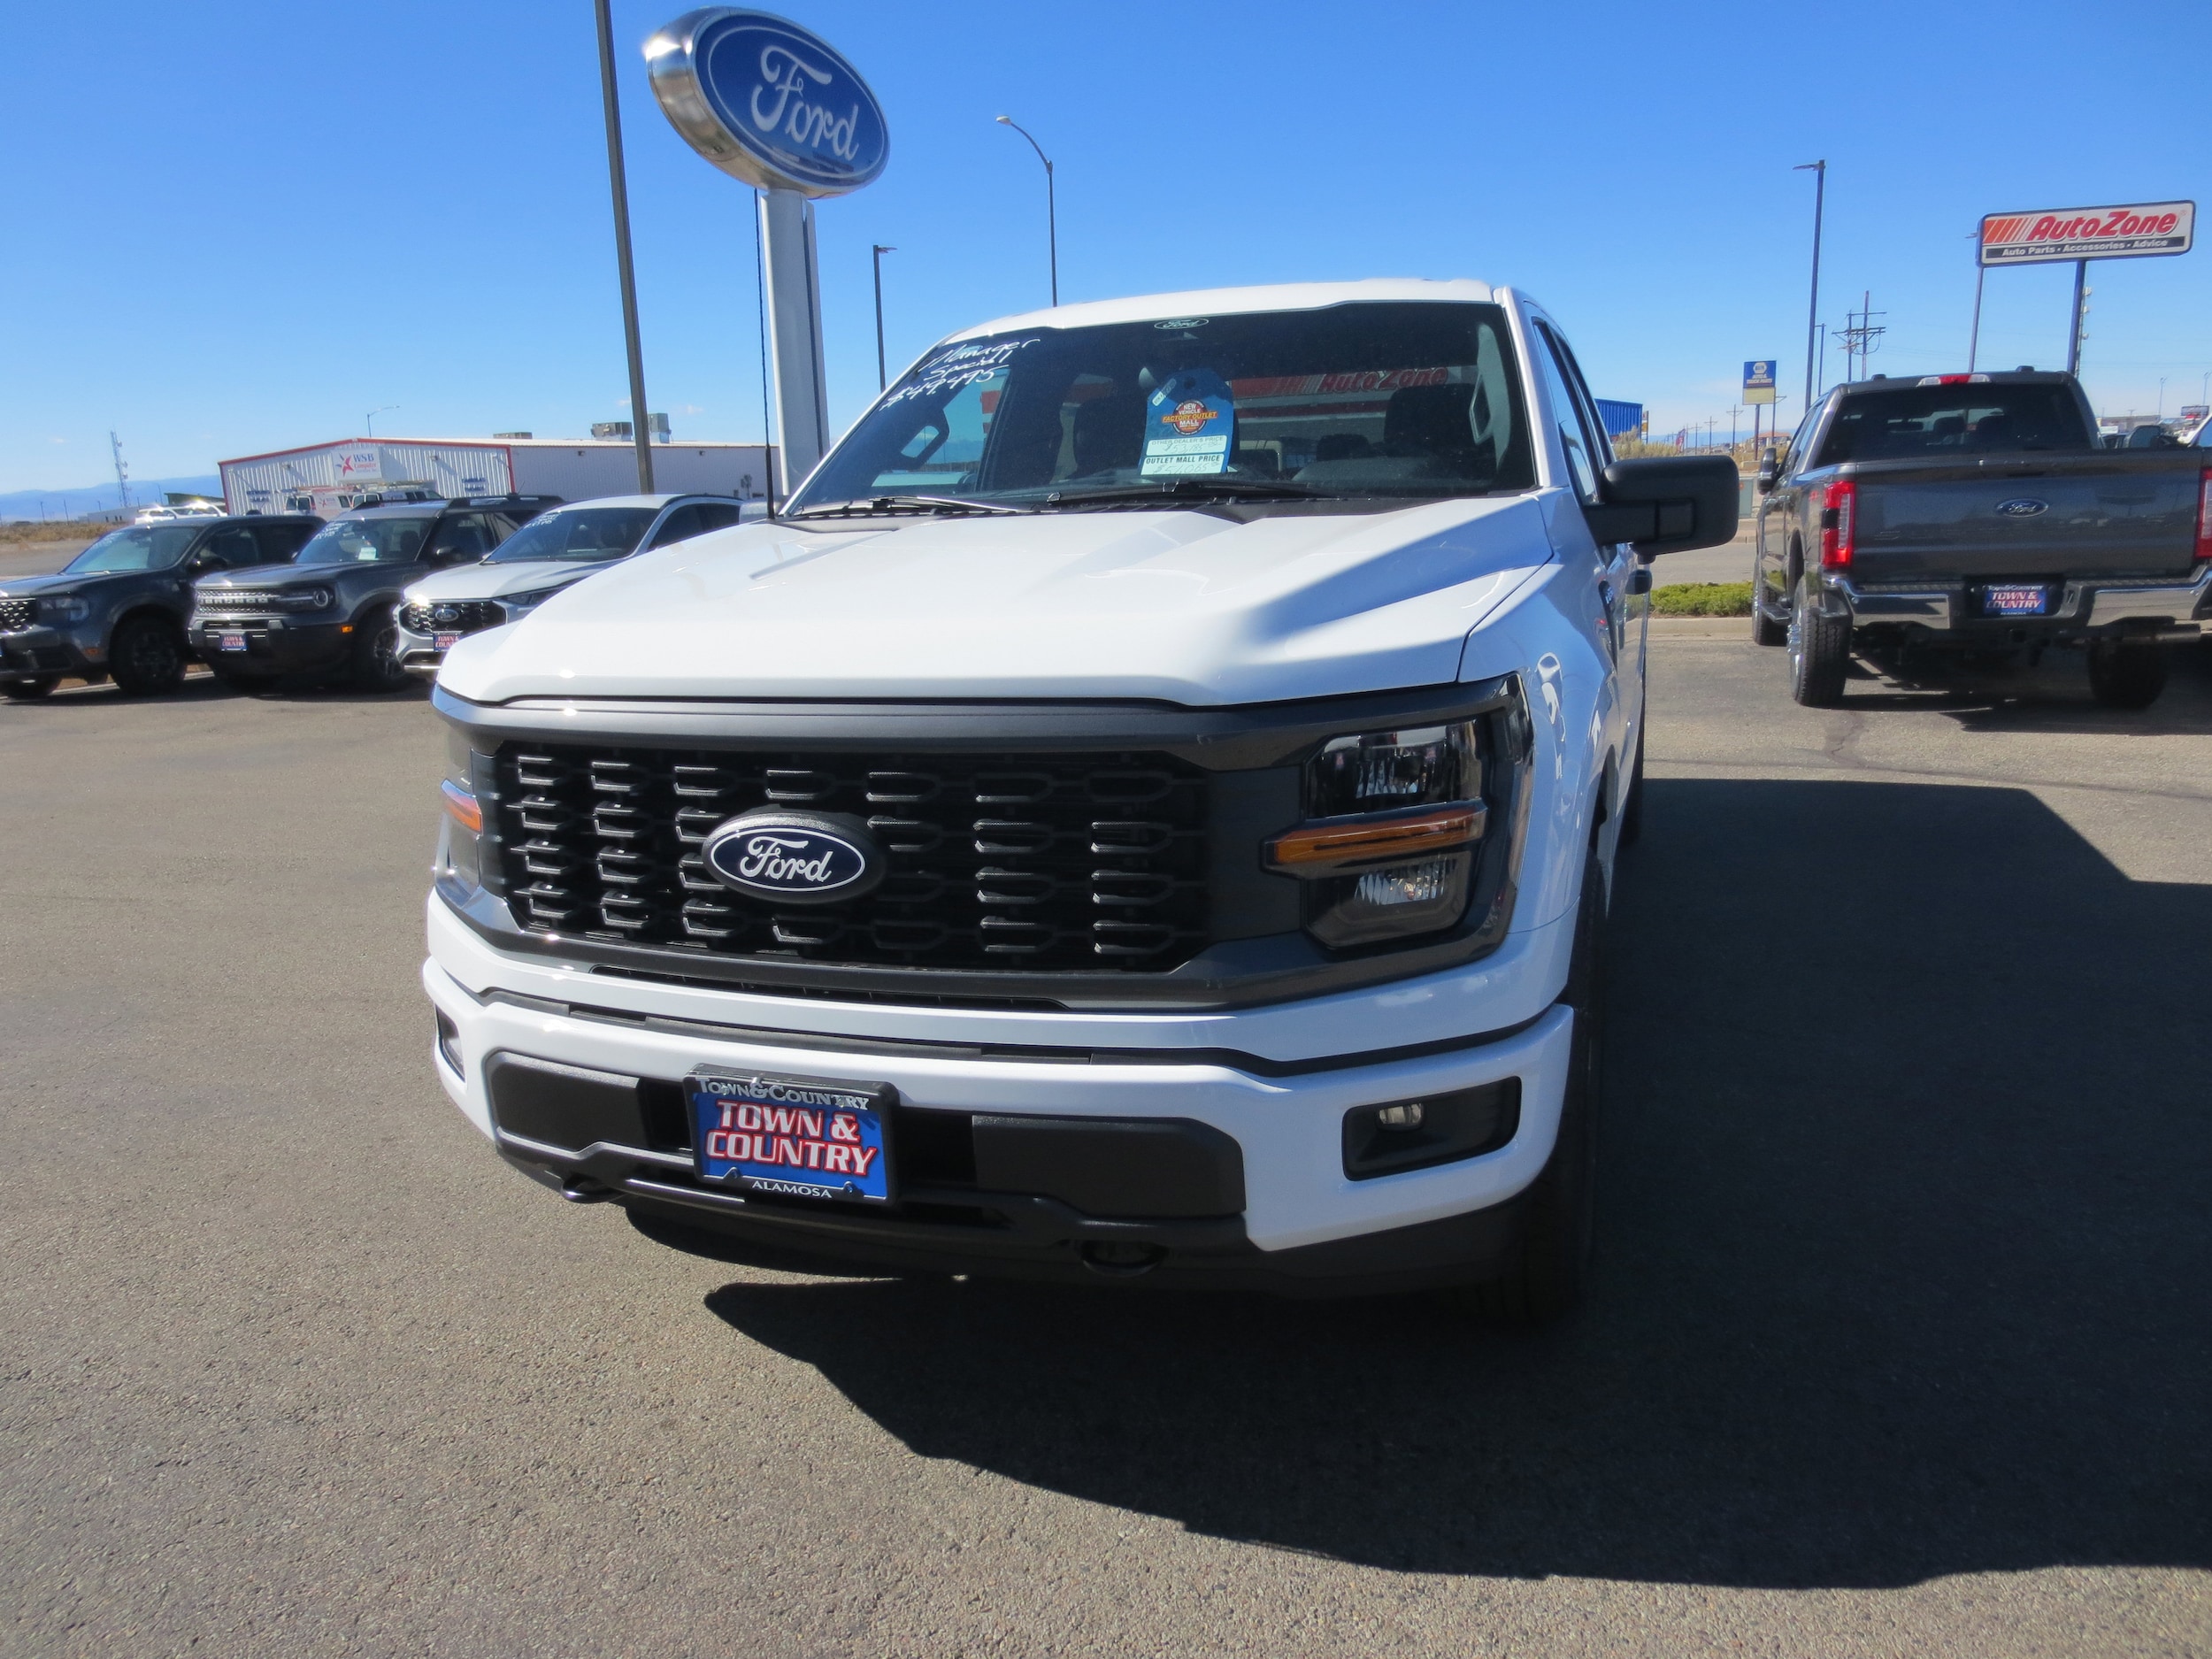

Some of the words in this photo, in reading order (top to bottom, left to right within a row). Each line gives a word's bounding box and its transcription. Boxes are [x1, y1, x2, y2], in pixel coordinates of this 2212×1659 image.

[750, 45, 859, 161] Ford
[2026, 211, 2177, 242] AutoZone
[2002, 248, 2025, 257] Auto
[2028, 245, 2055, 255] Parts
[2062, 242, 2125, 252] Accessories
[2132, 239, 2168, 248] Advice
[917, 338, 1041, 373] Manager
[740, 836, 833, 882] Ford
[717, 1100, 824, 1138] TOWN
[830, 1112, 861, 1142] &
[706, 1130, 878, 1177] COUNTRY
[752, 1180, 833, 1199] ALAMOSA
